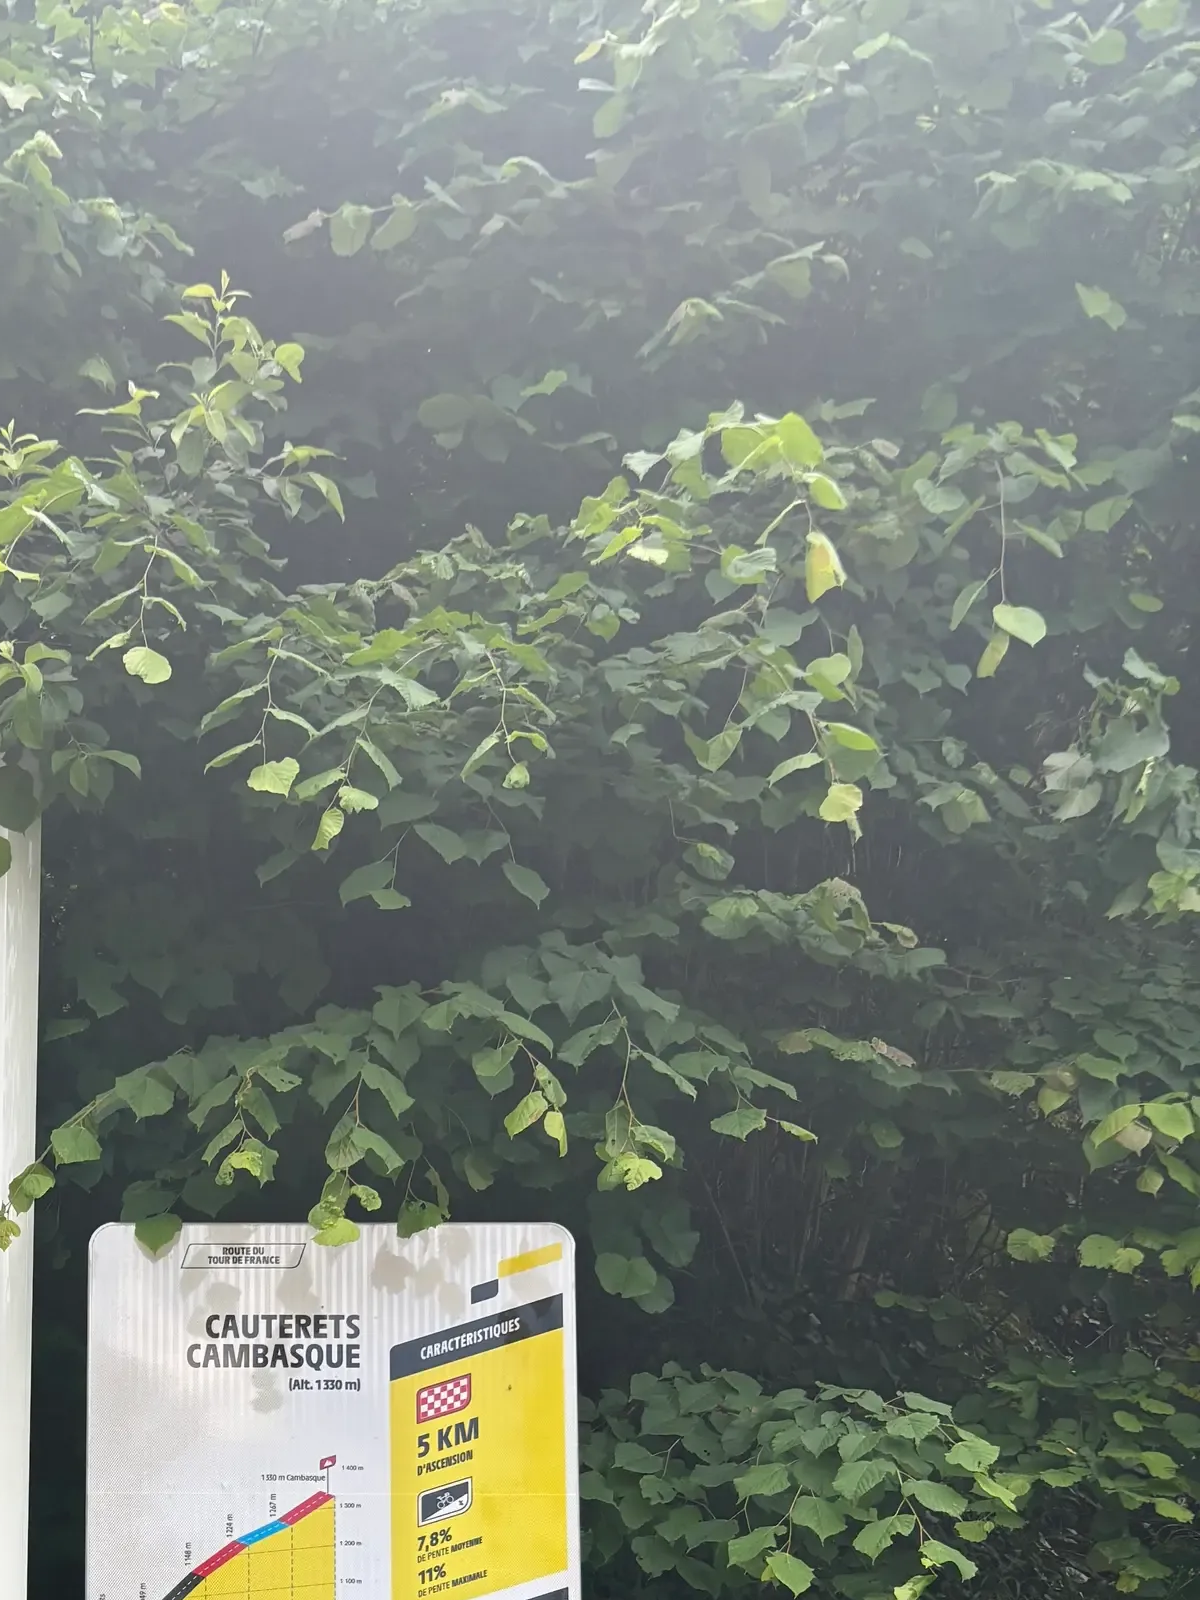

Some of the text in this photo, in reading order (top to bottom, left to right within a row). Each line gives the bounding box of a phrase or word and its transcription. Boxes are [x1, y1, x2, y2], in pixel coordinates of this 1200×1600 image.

[208, 1256, 280, 1264] TOUR DE FRANCE
[222, 1247, 264, 1255] ROUTE DU
[205, 1314, 360, 1339] CAUTERETS
[420, 1317, 520, 1360] CARACTÉRISTIQUES
[187, 1343, 360, 1371] CAMBASQUE
[289, 1378, 313, 1391] (Alt.
[345, 1378, 361, 1391] m)
[418, 1416, 479, 1458] 5 KM
[417, 1449, 473, 1476] D'ASCENSION
[286, 1474, 326, 1482] Cambasque
[417, 1527, 452, 1552] 7,8%
[417, 1536, 483, 1563] DE PENTE MOYENNE
[418, 1563, 447, 1585] 11%
[418, 1569, 488, 1598] DE PENTE MAXIMALE
